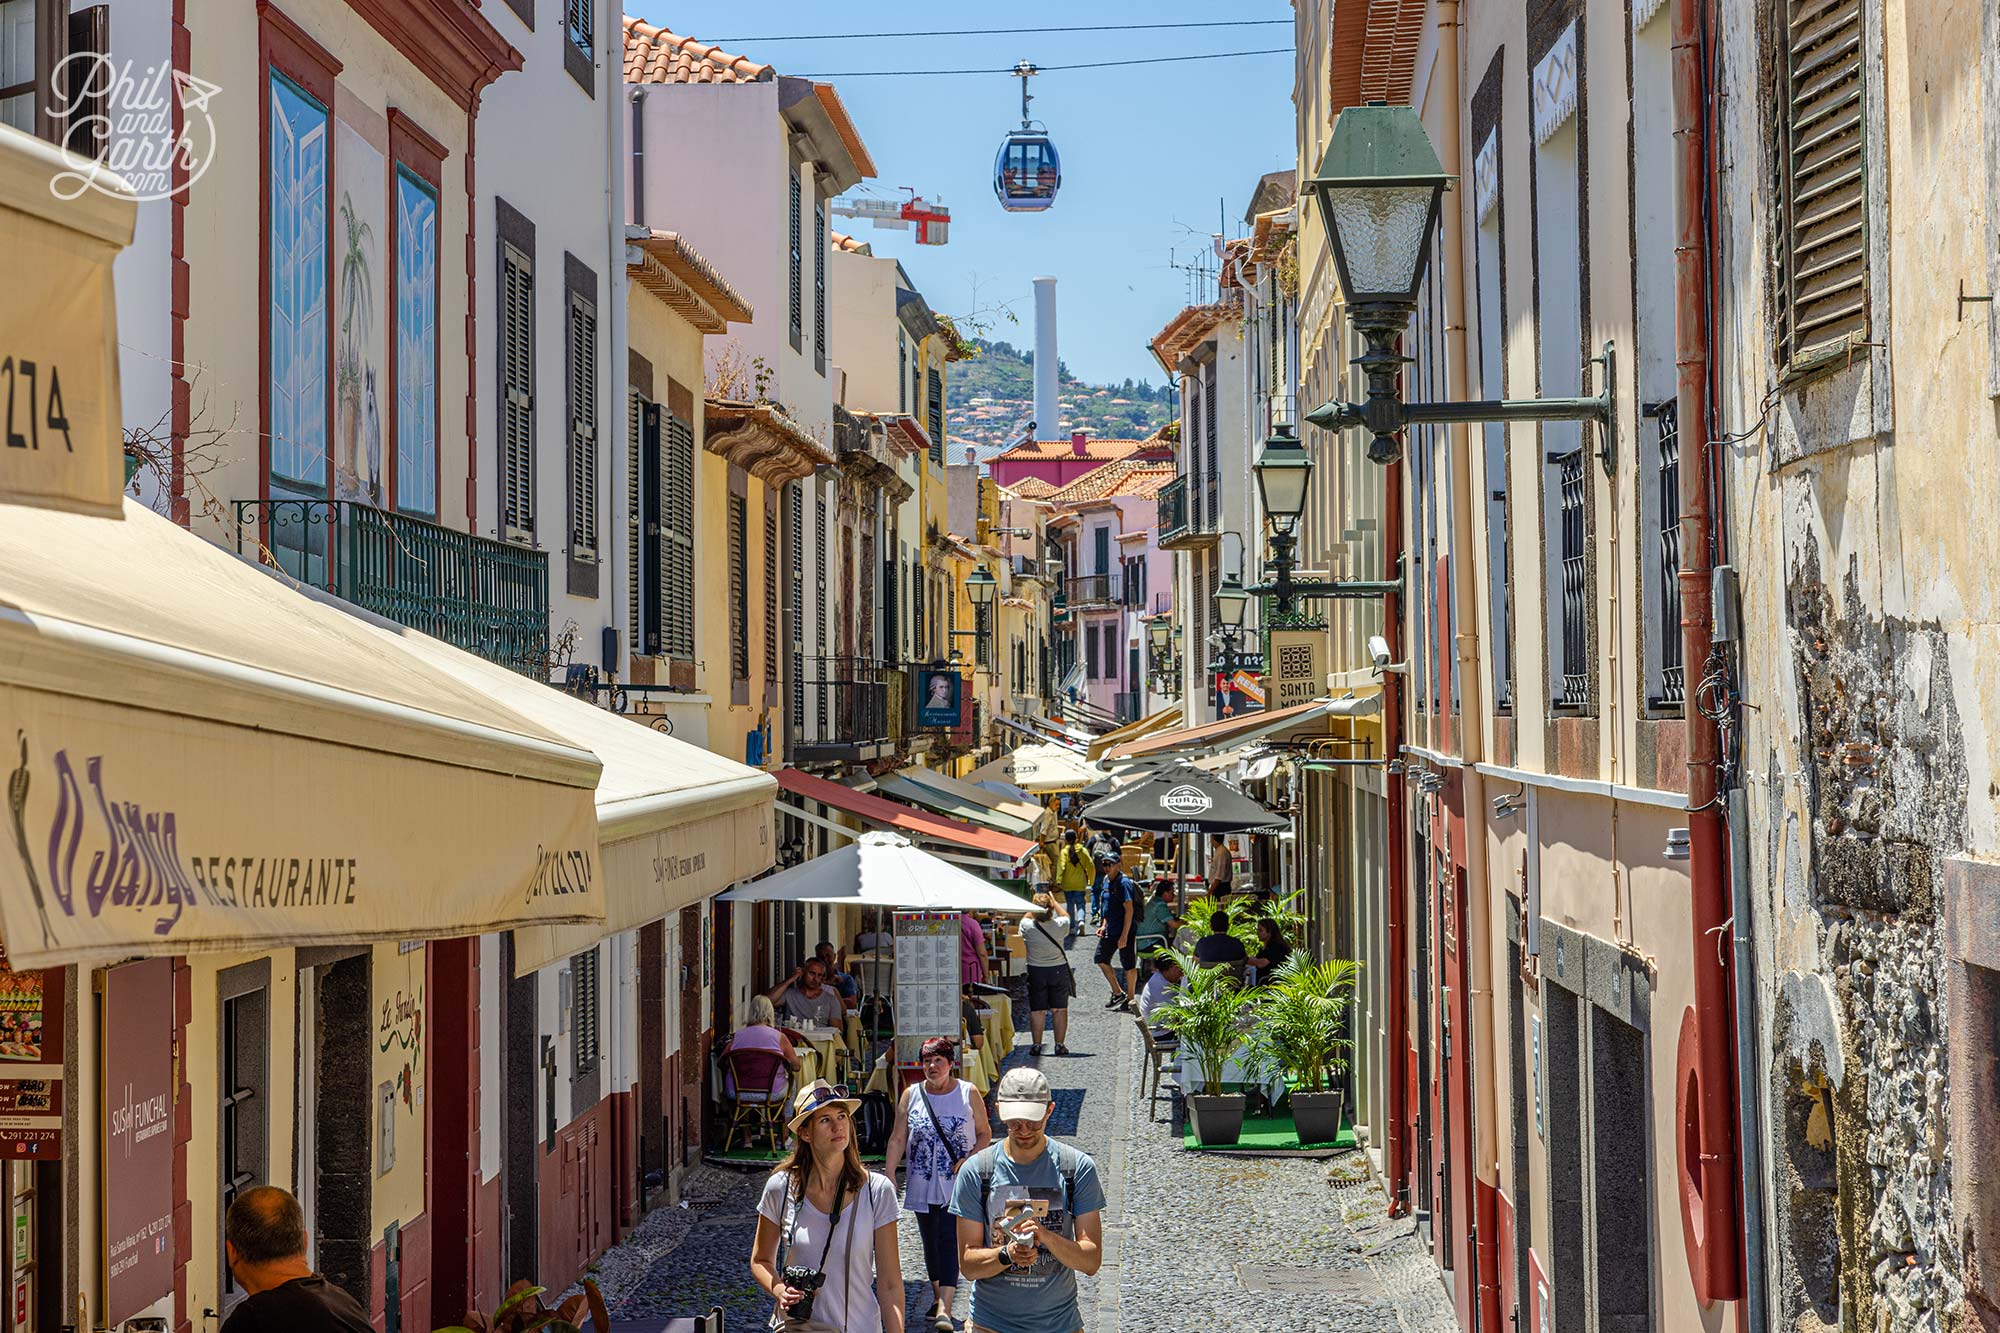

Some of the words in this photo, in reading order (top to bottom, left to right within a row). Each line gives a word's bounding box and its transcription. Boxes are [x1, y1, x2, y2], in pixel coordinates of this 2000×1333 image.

[1, 355, 73, 453] 274
[1280, 682, 1315, 697] SANTA
[1167, 796, 1206, 805] CORAL
[1172, 823, 1201, 833] CORAL
[48, 749, 84, 917] O
[86, 755, 198, 936] Jango
[191, 856, 357, 909] RESTAURANTE
[136, 1093, 168, 1130] FUNCHAL
[8, 1131, 22, 1140] 291
[24, 1131, 38, 1140] 221
[40, 1131, 55, 1140] 274
